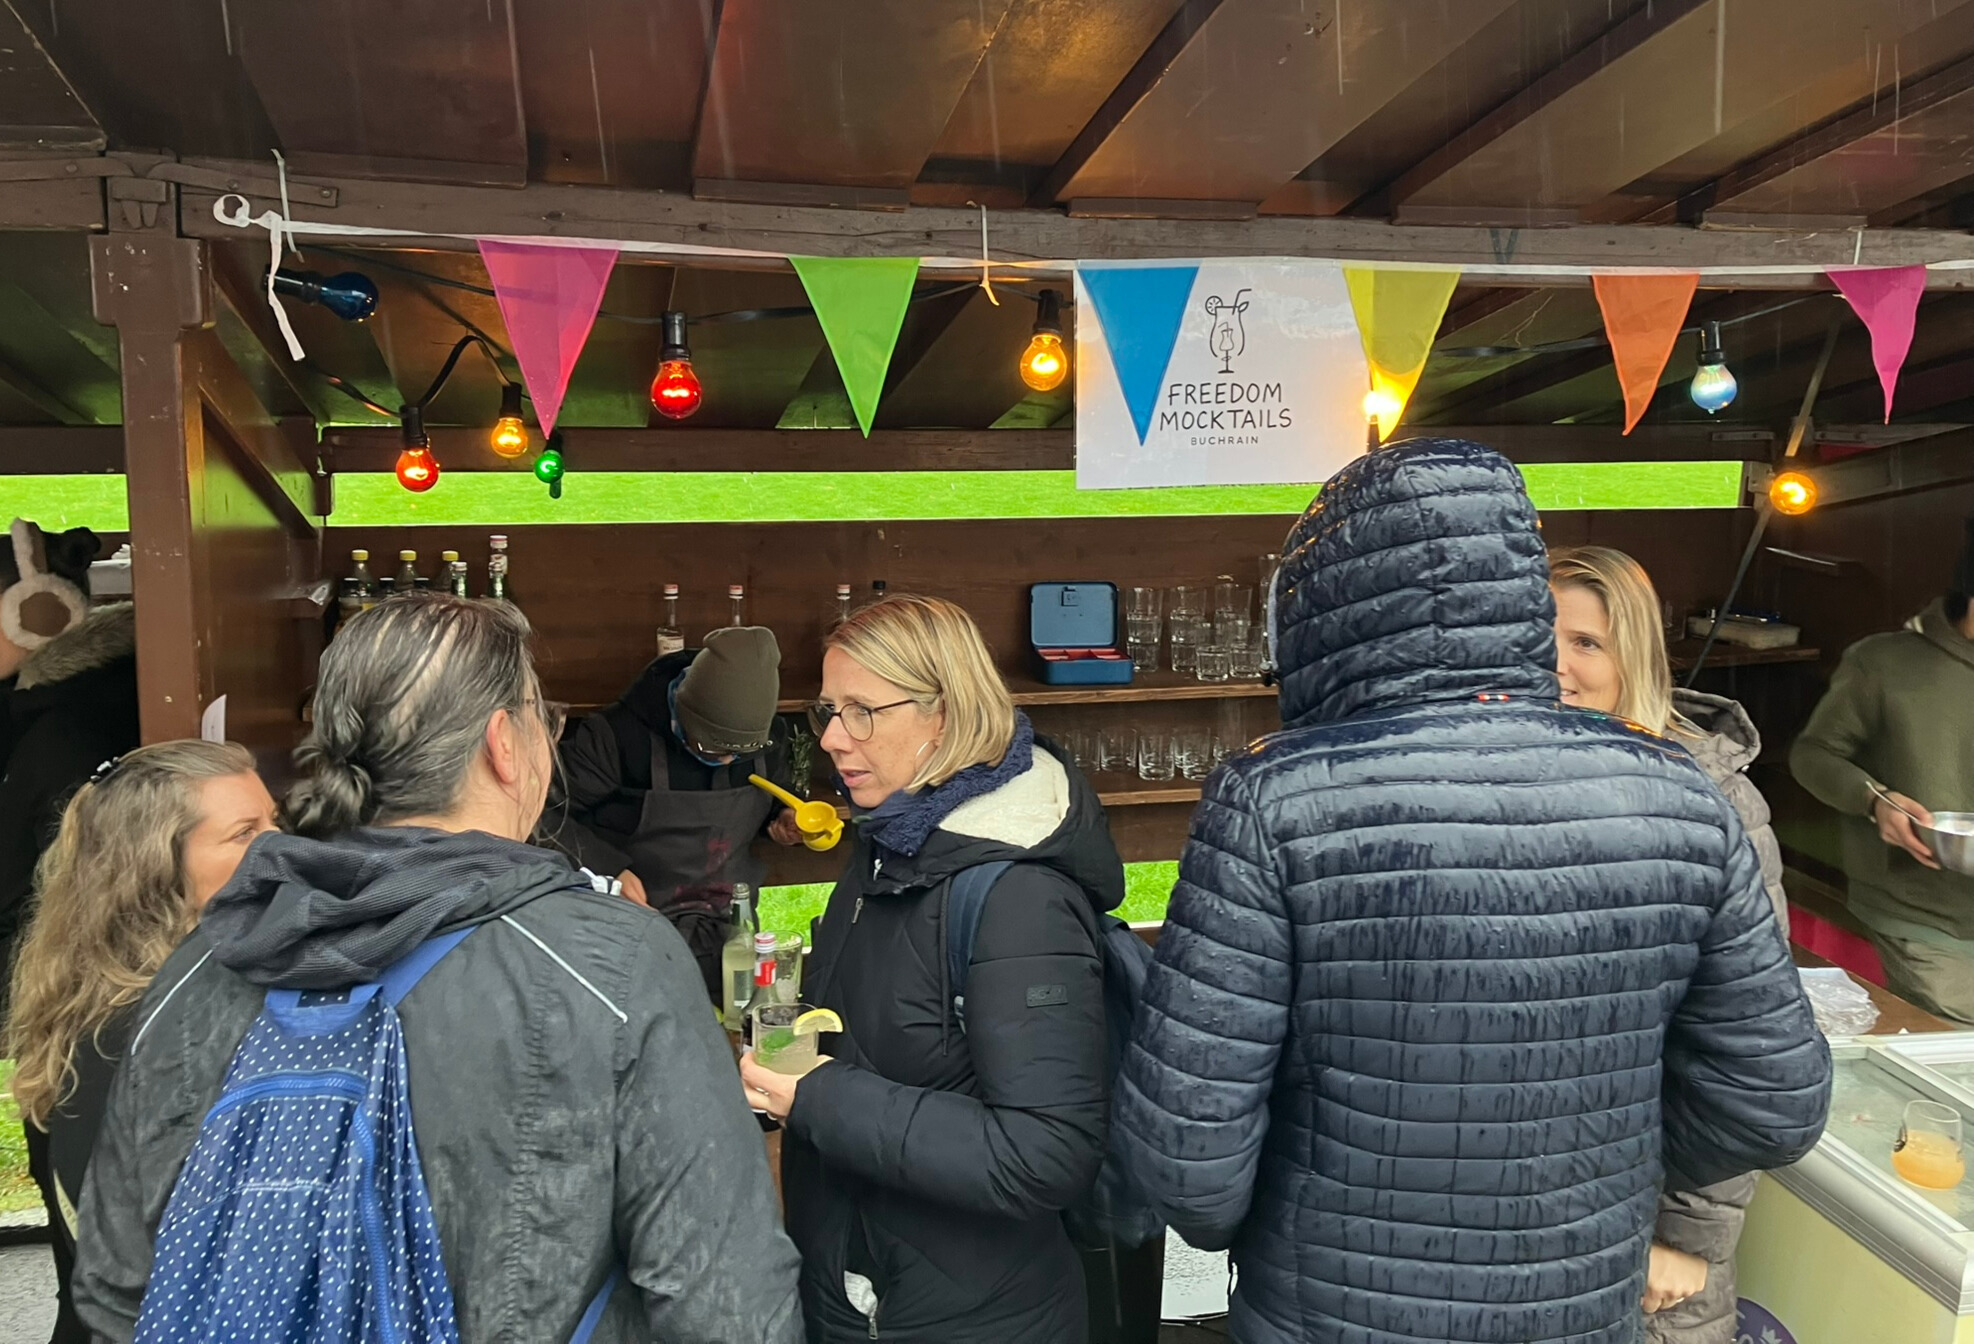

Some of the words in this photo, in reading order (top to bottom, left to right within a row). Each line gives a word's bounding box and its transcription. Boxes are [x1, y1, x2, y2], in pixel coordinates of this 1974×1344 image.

[1167, 382, 1282, 406] FREEDOM
[1159, 408, 1292, 432] MOCKTAILS
[1190, 435, 1259, 446] BUCHRAIN
